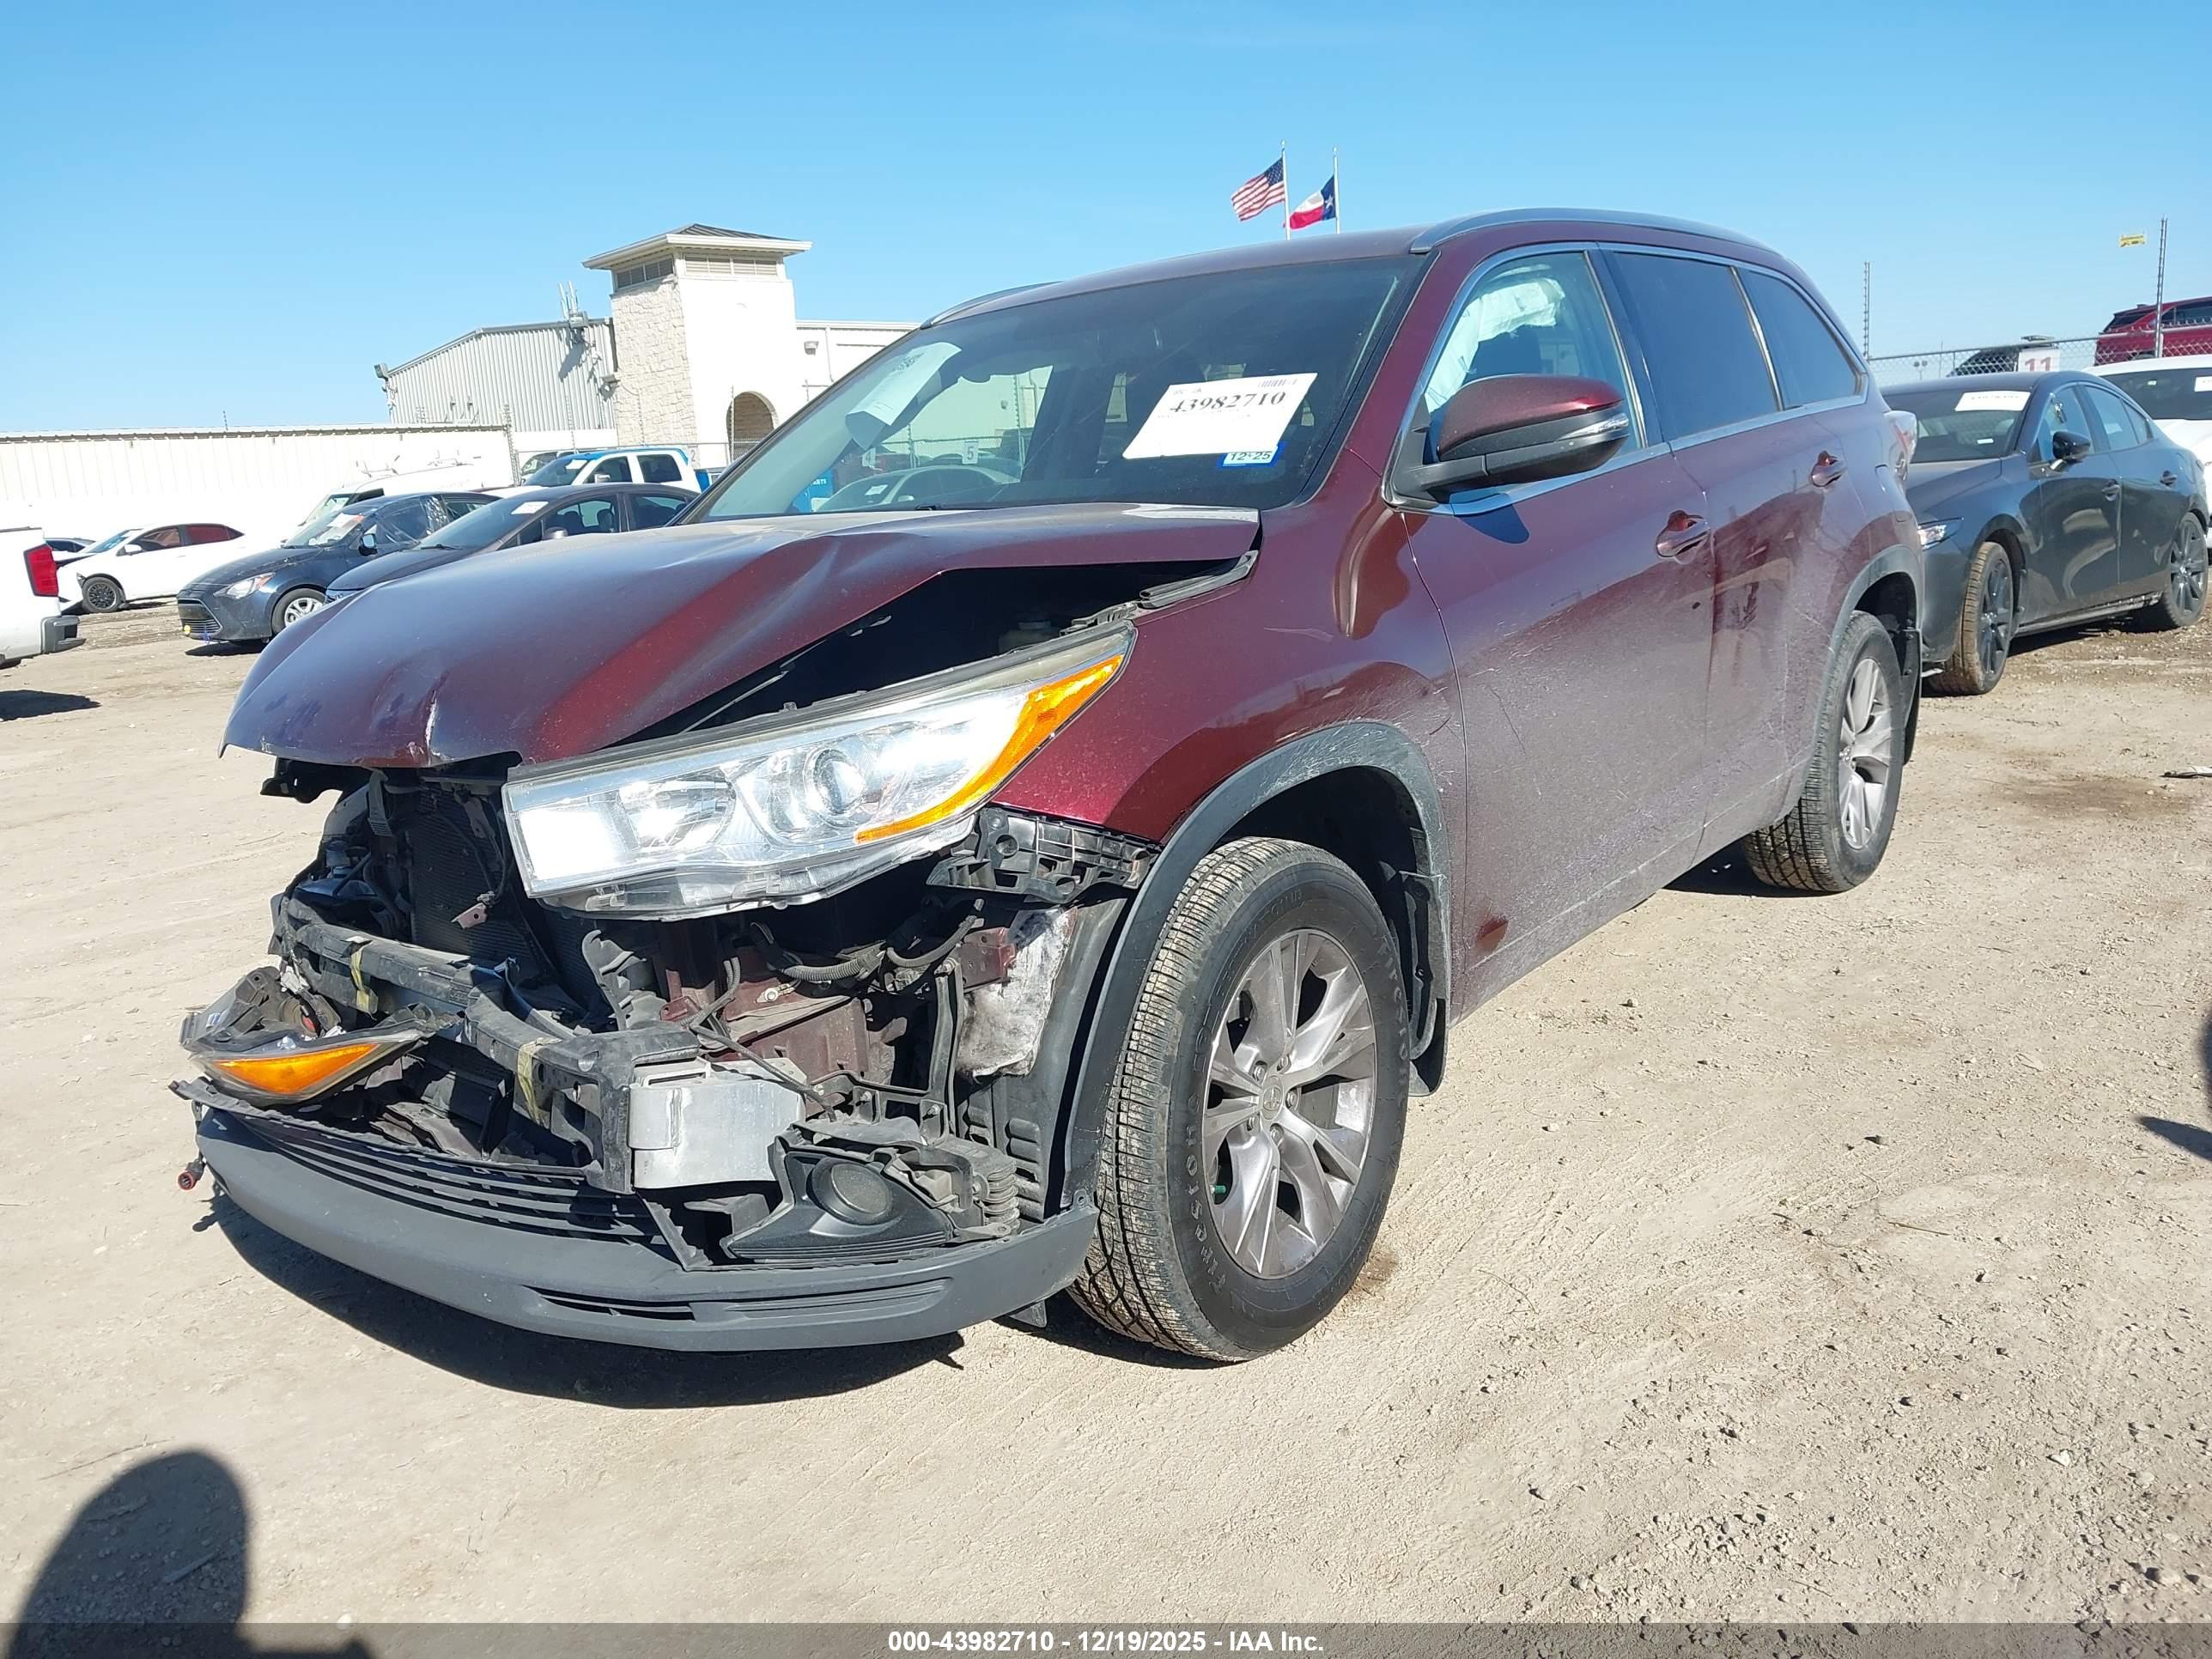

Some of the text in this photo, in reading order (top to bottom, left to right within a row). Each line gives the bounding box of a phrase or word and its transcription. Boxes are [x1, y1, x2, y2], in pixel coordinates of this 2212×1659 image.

[2025, 357, 2051, 371] 11
[1170, 391, 1286, 413] 43982710
[967, 446, 975, 460] 5
